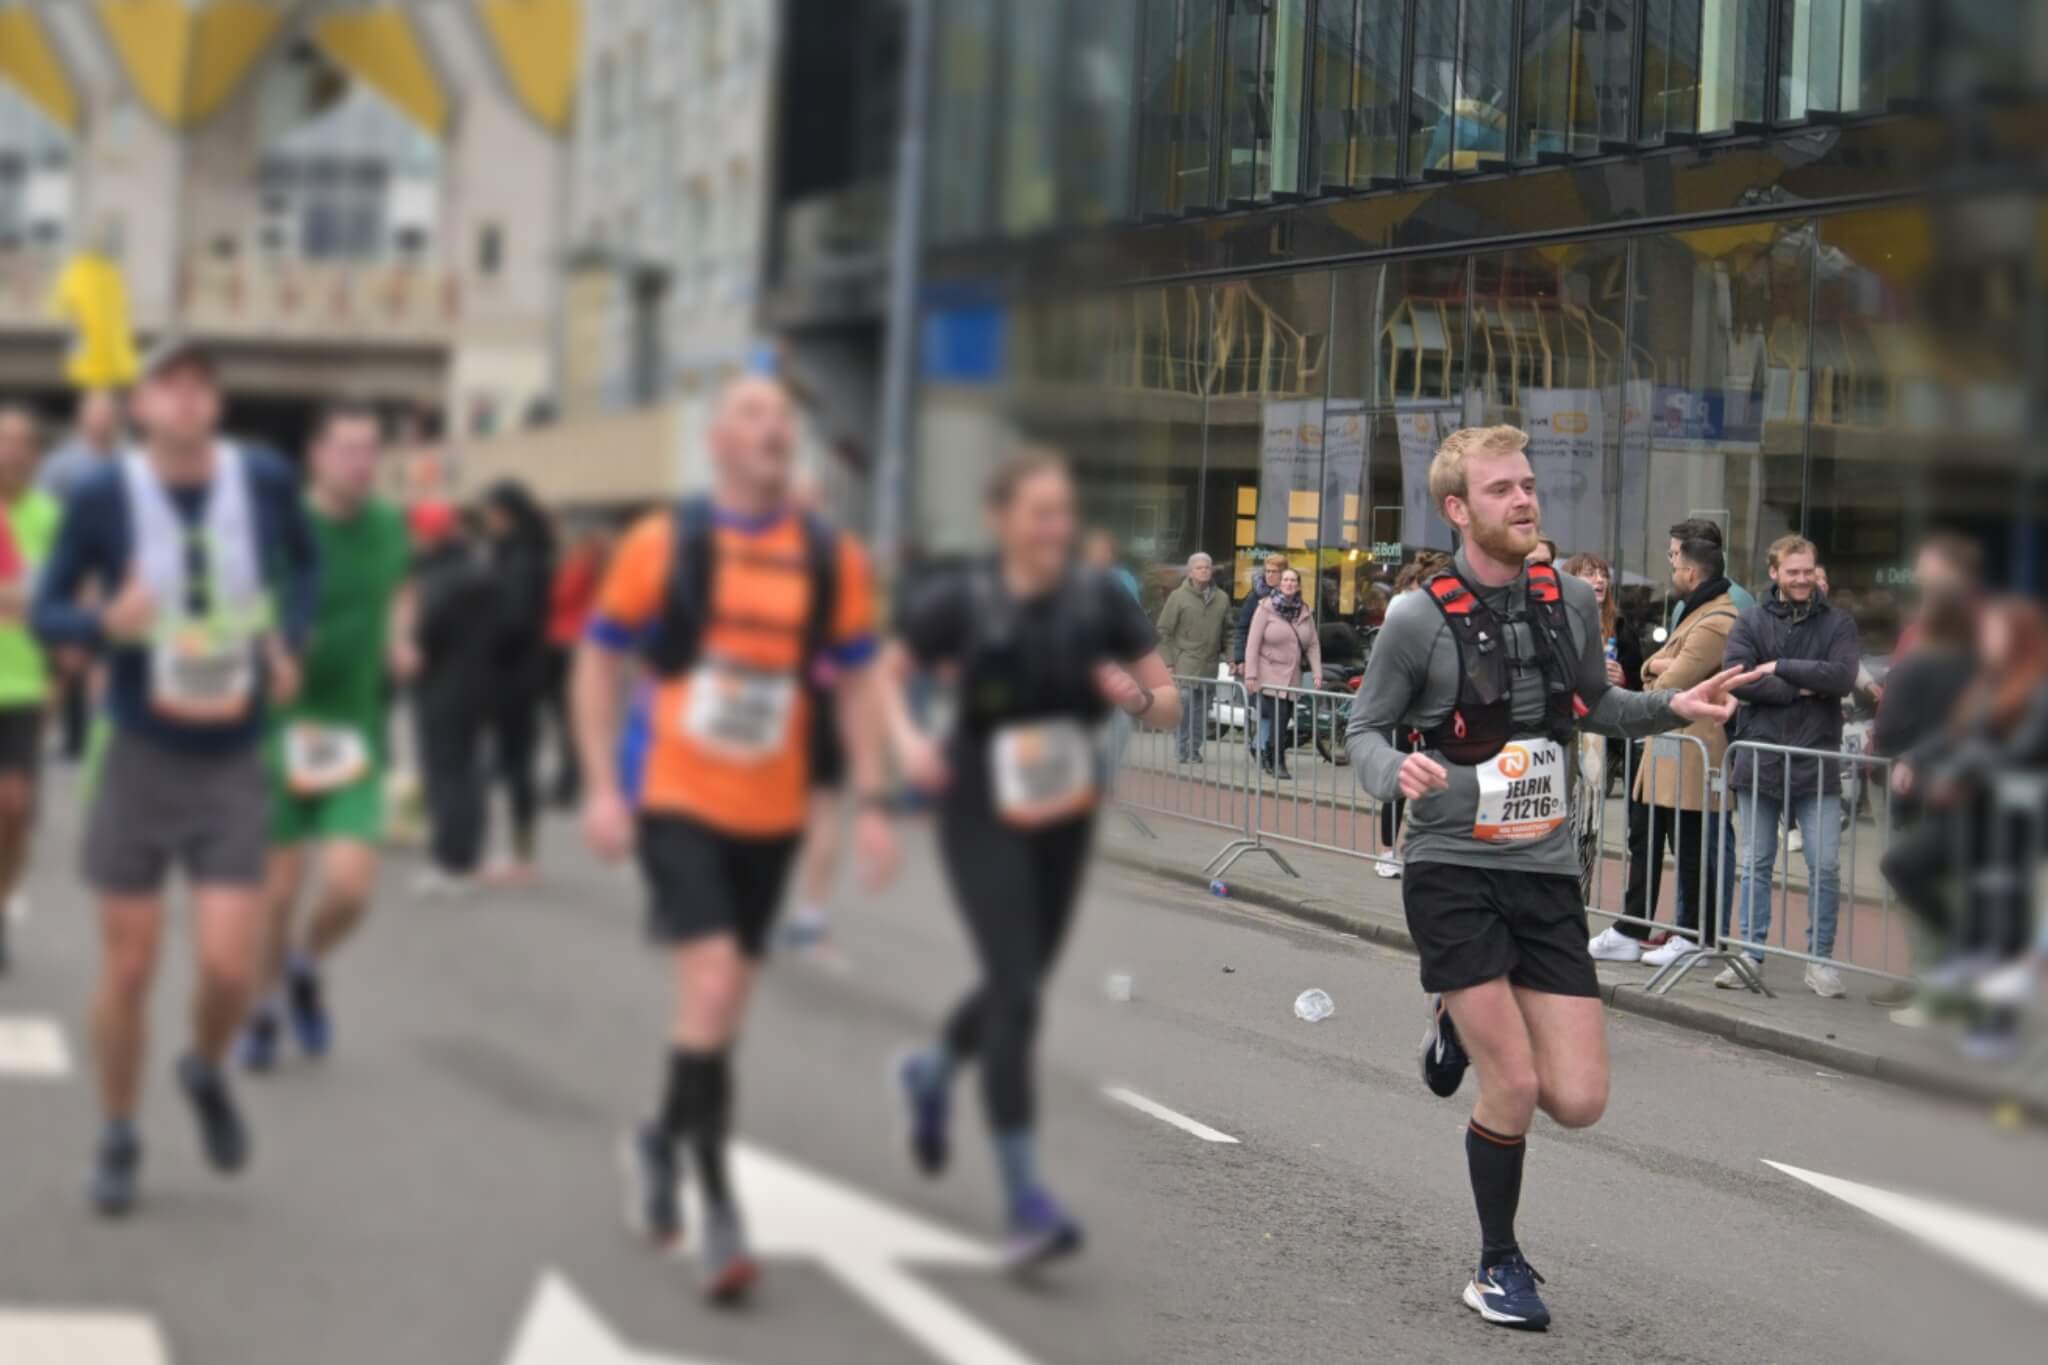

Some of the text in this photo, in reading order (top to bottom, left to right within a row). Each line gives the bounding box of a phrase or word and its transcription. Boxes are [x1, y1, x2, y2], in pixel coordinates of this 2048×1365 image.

[1533, 750, 1556, 766] NN
[1506, 776, 1552, 799] JELRIK
[1502, 797, 1551, 821] 21216
